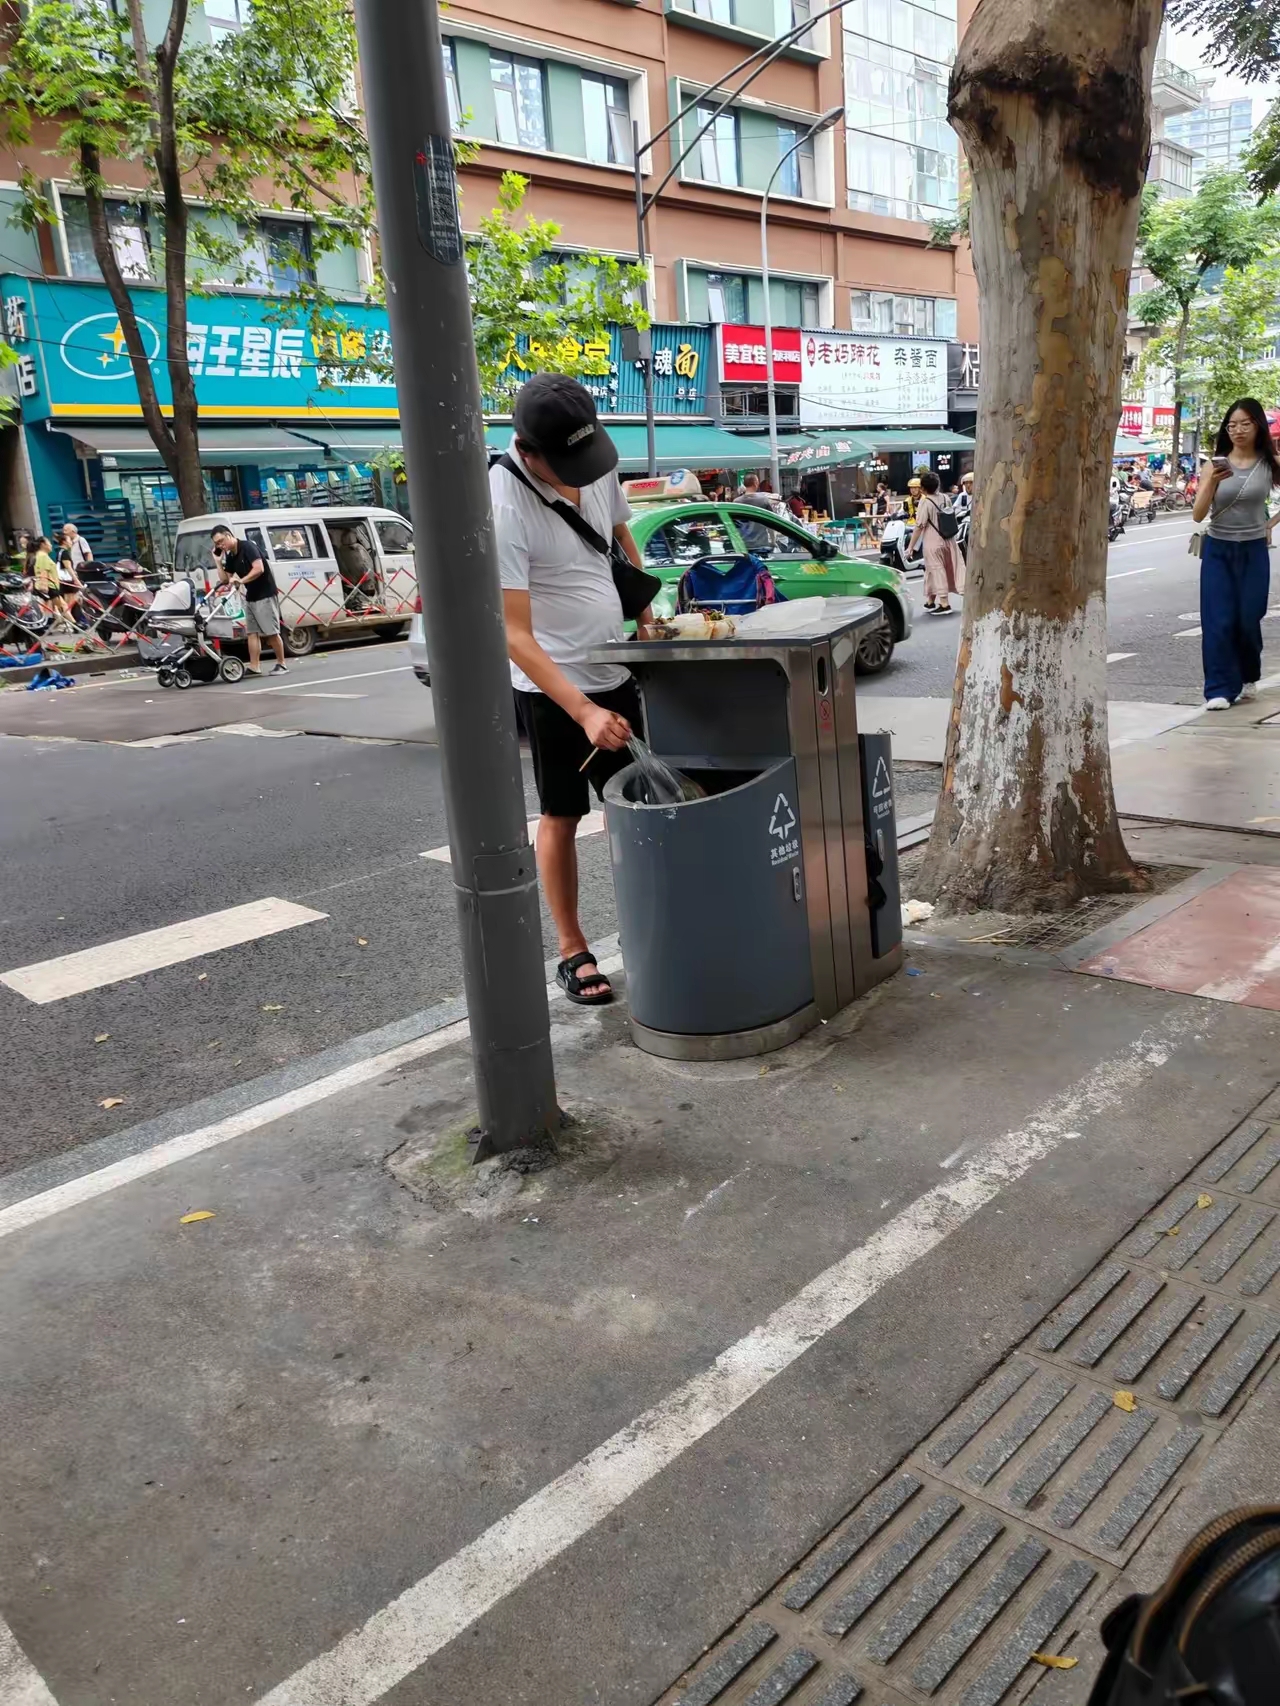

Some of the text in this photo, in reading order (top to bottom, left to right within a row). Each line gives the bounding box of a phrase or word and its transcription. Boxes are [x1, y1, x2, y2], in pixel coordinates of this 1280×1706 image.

[725, 343, 767, 366] 美宜佳
[817, 341, 881, 367] 老妈蹄花
